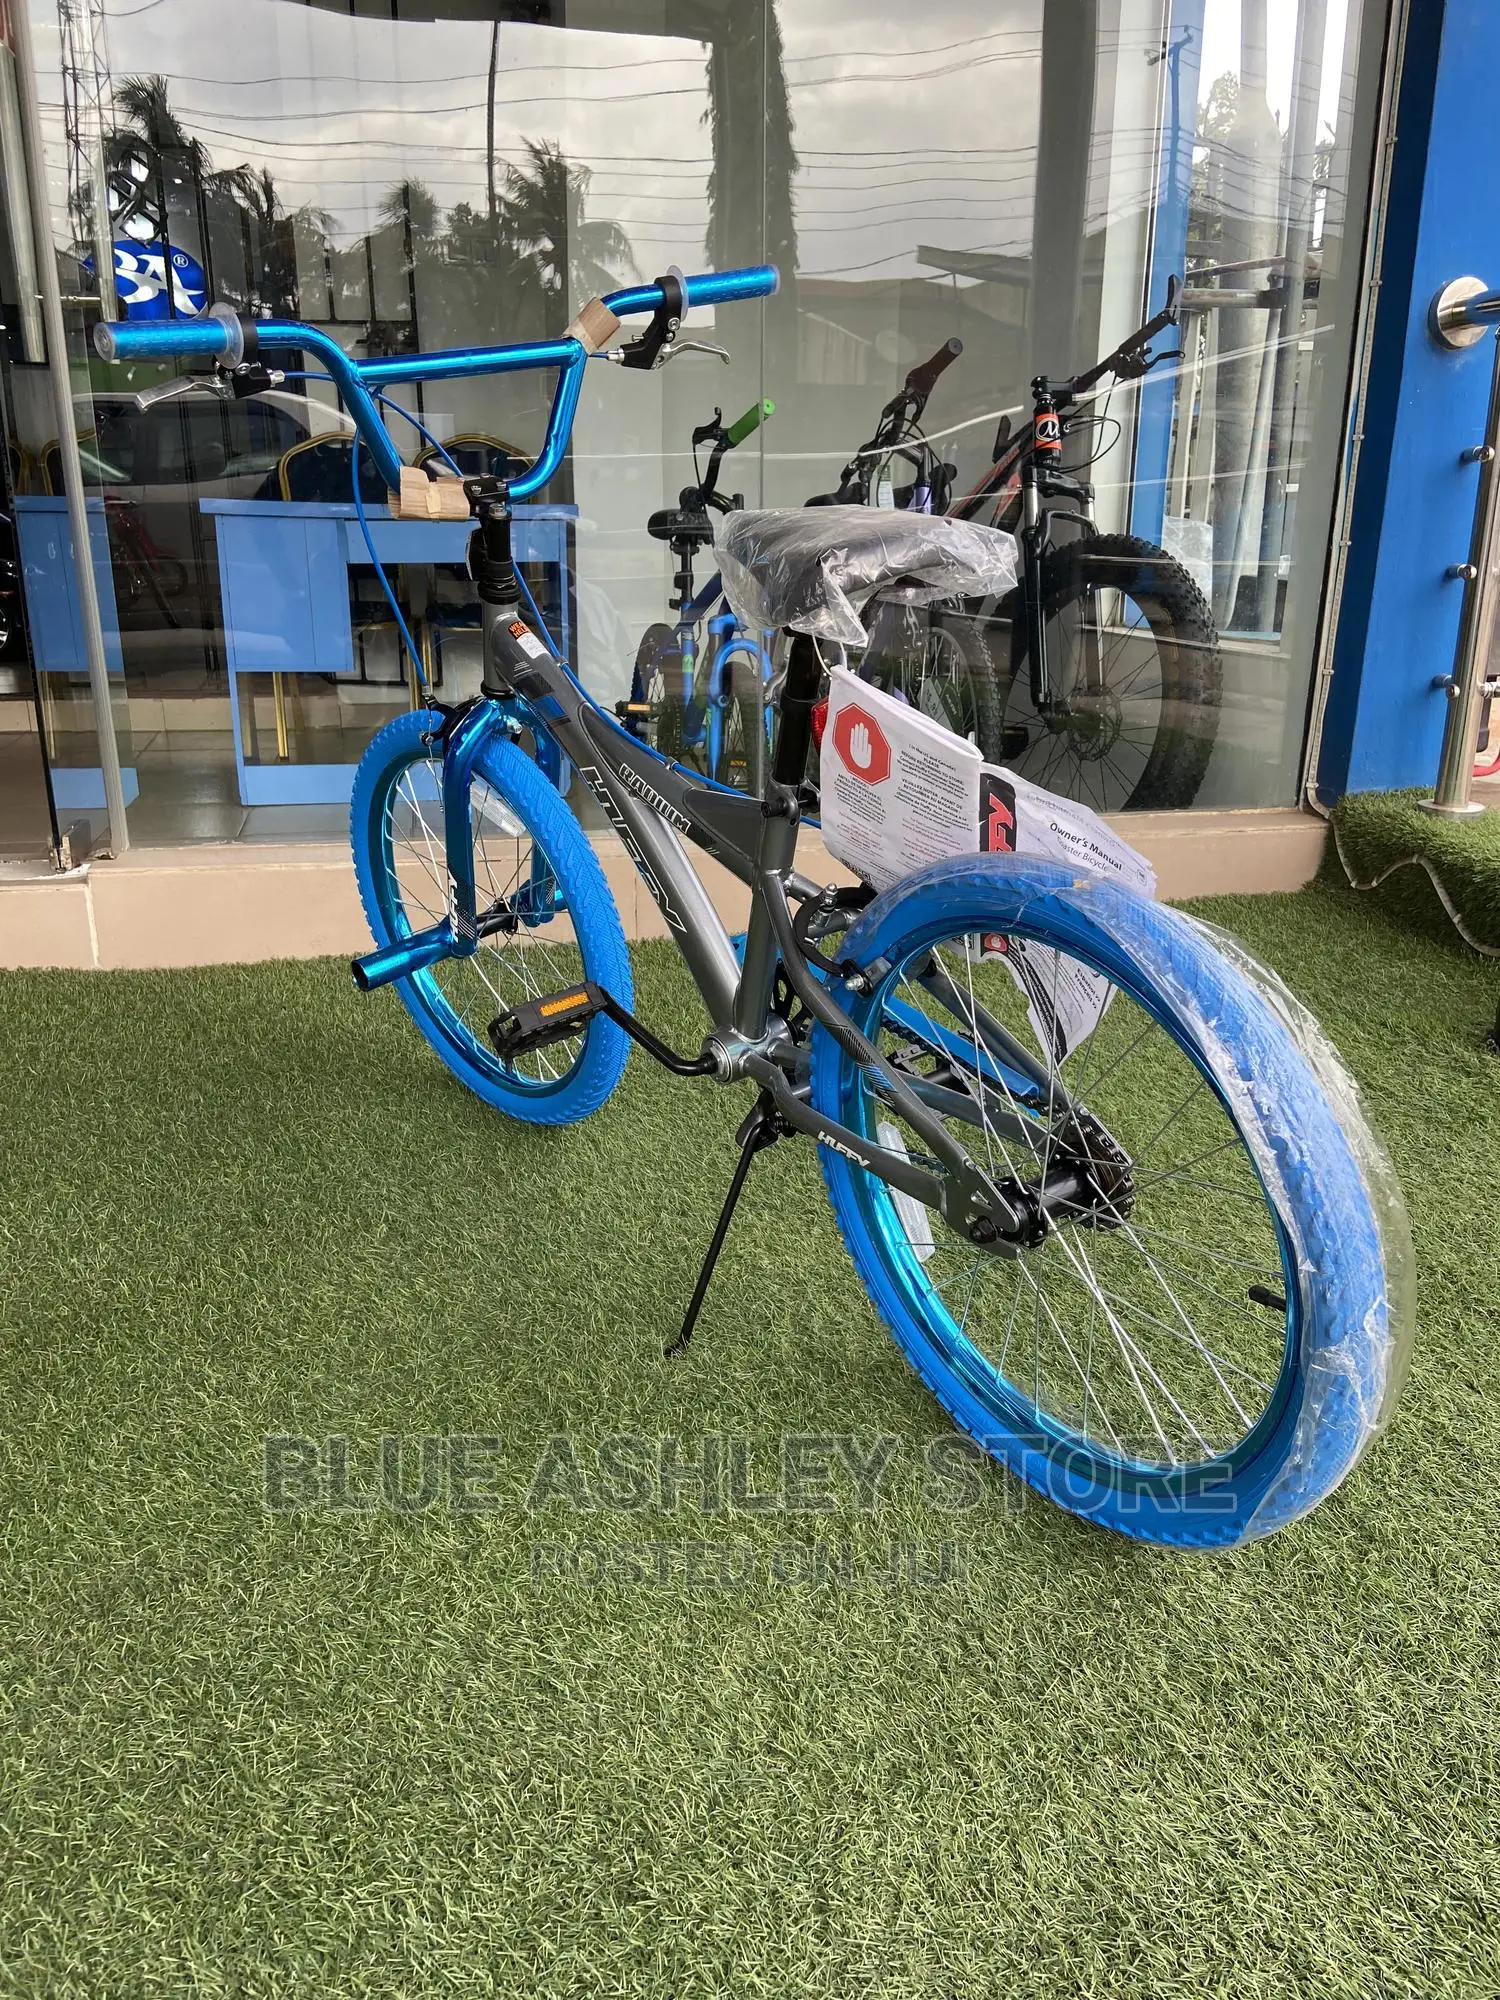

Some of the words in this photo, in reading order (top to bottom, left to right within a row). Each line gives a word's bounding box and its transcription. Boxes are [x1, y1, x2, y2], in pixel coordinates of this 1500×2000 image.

[618, 762, 692, 834] RADIUM
[989, 792, 1014, 852] FY
[1089, 843, 1122, 871] Manual
[817, 1130, 871, 1167] HUFFY
